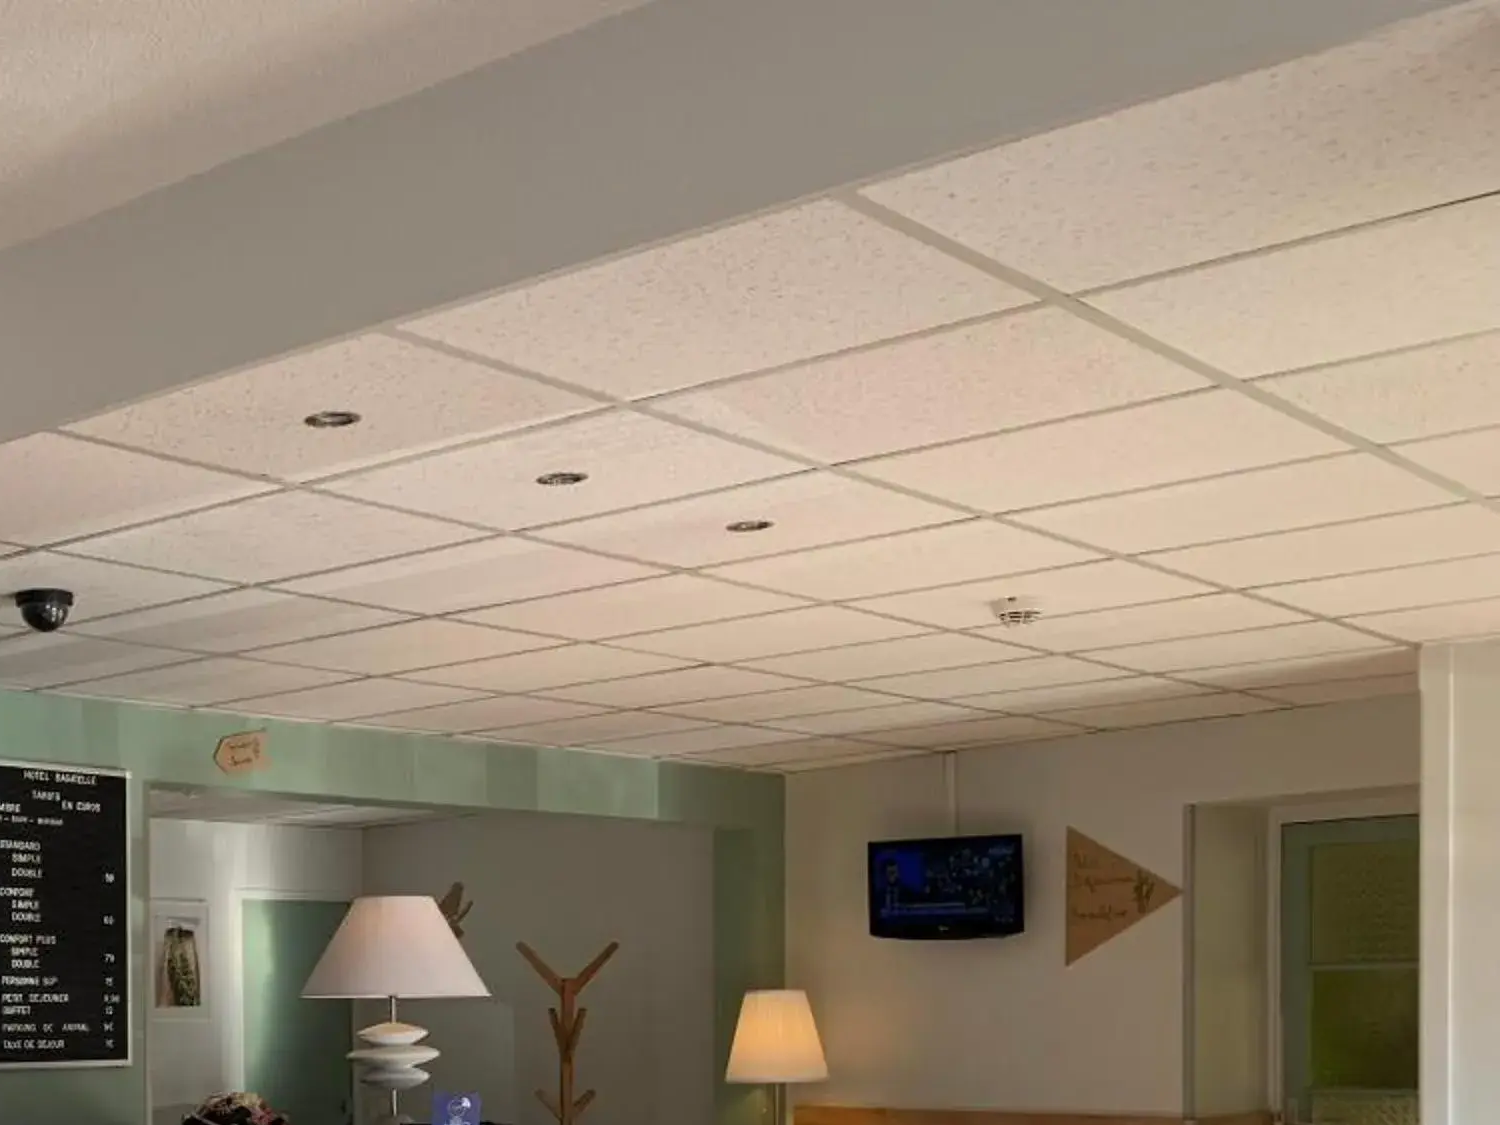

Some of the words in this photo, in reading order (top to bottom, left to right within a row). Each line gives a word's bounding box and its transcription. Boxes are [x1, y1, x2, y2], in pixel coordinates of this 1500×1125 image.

[23, 770, 49, 781] HOTEL
[0, 839, 41, 851] STANDARD
[11, 853, 41, 863] SIMPLE
[11, 867, 42, 878] DOUBLE
[11, 899, 40, 910] SIMPLE
[11, 912, 41, 923] DOUBLE
[0, 933, 33, 944] CONFORT
[36, 935, 57, 945] PLUS
[11, 959, 40, 969] DOUBLE
